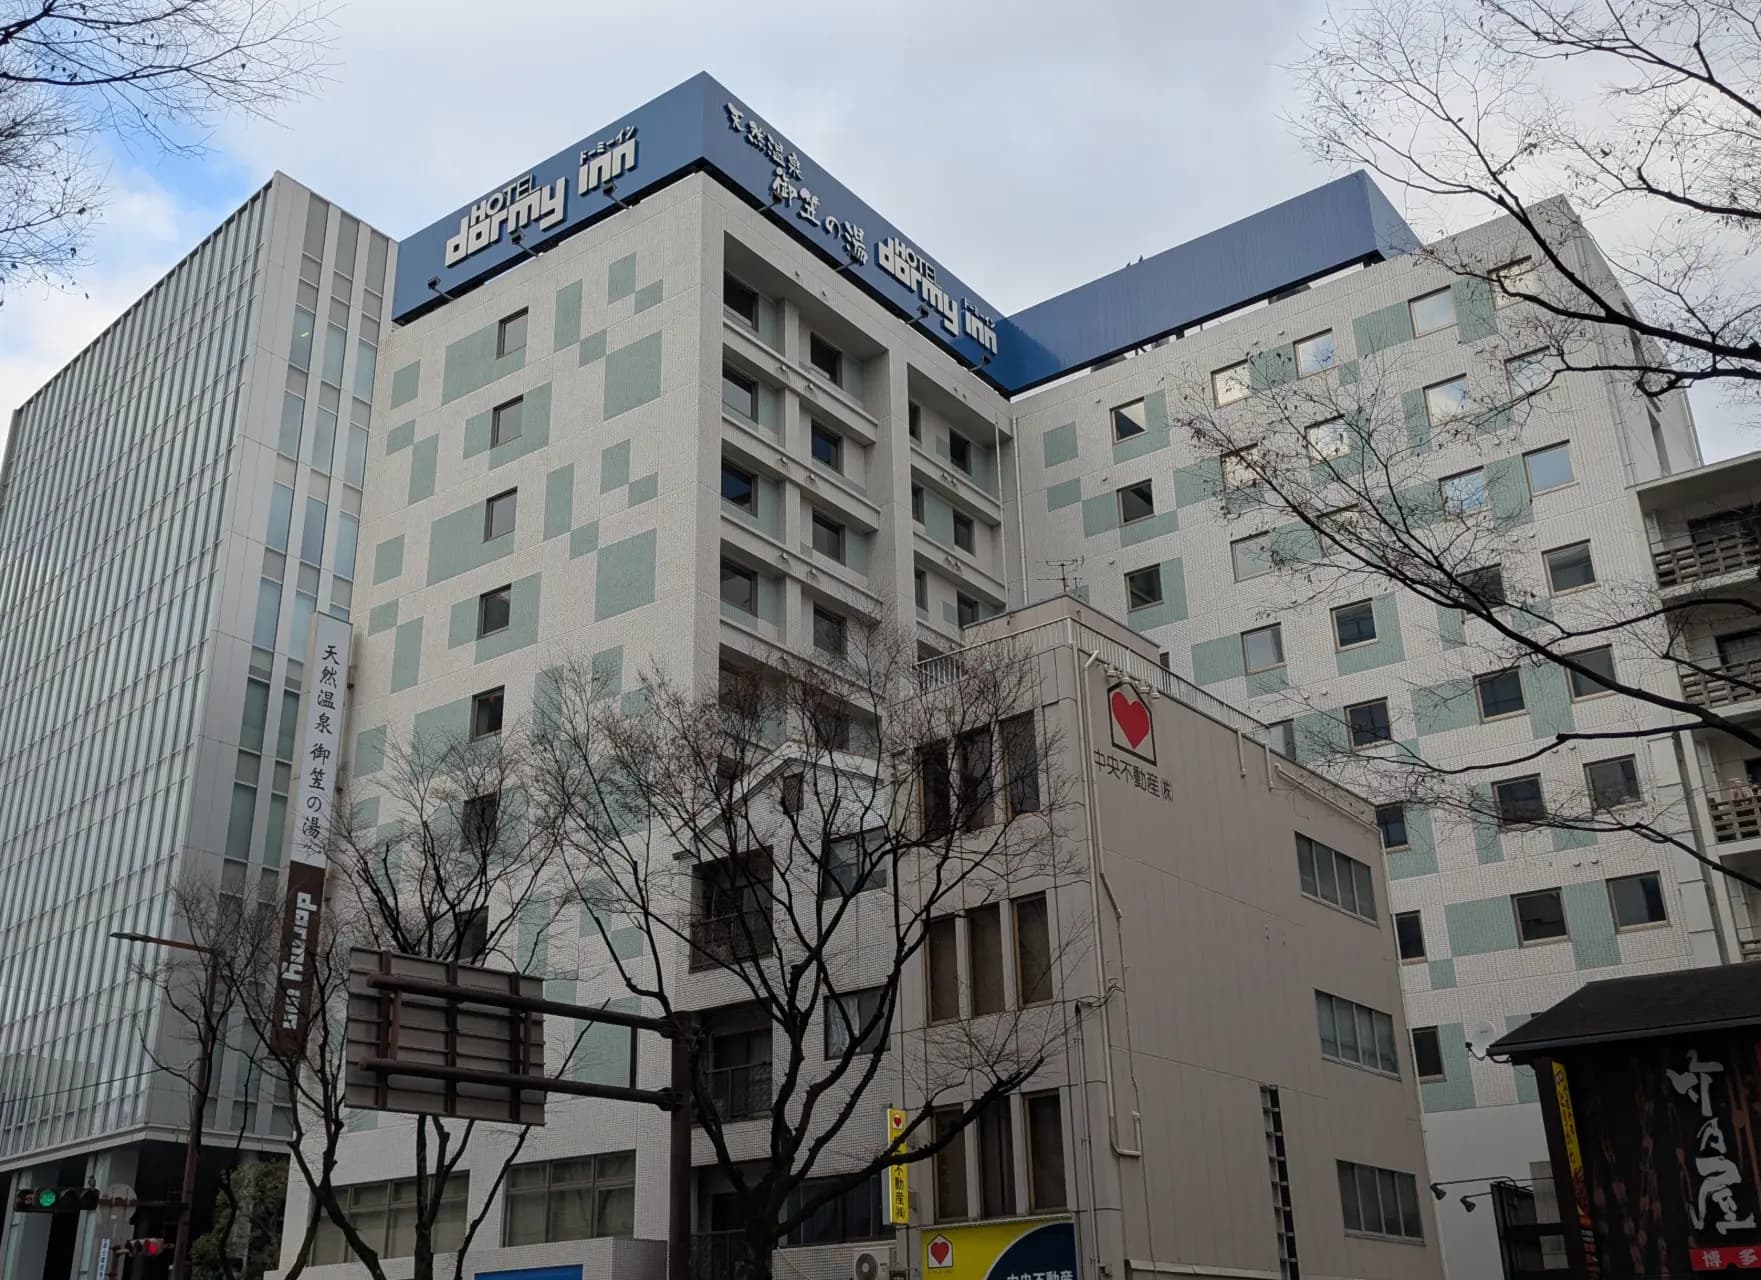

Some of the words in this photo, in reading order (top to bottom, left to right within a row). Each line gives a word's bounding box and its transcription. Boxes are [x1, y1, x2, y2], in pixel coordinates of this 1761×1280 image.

[579, 125, 636, 166] ドーミーイン
[727, 102, 804, 180] 天然温泉
[445, 176, 566, 267] dormy
[578, 138, 636, 195] inn
[470, 173, 542, 227] HOTEL
[772, 166, 869, 265] 御笠の湯
[878, 237, 958, 336] dormy
[965, 310, 997, 355] inn
[894, 237, 942, 289] HOTEL
[313, 645, 340, 735] 天然温泉
[302, 743, 331, 840] 御笠の湯
[281, 891, 318, 982] dormy
[282, 988, 301, 1030] inn
